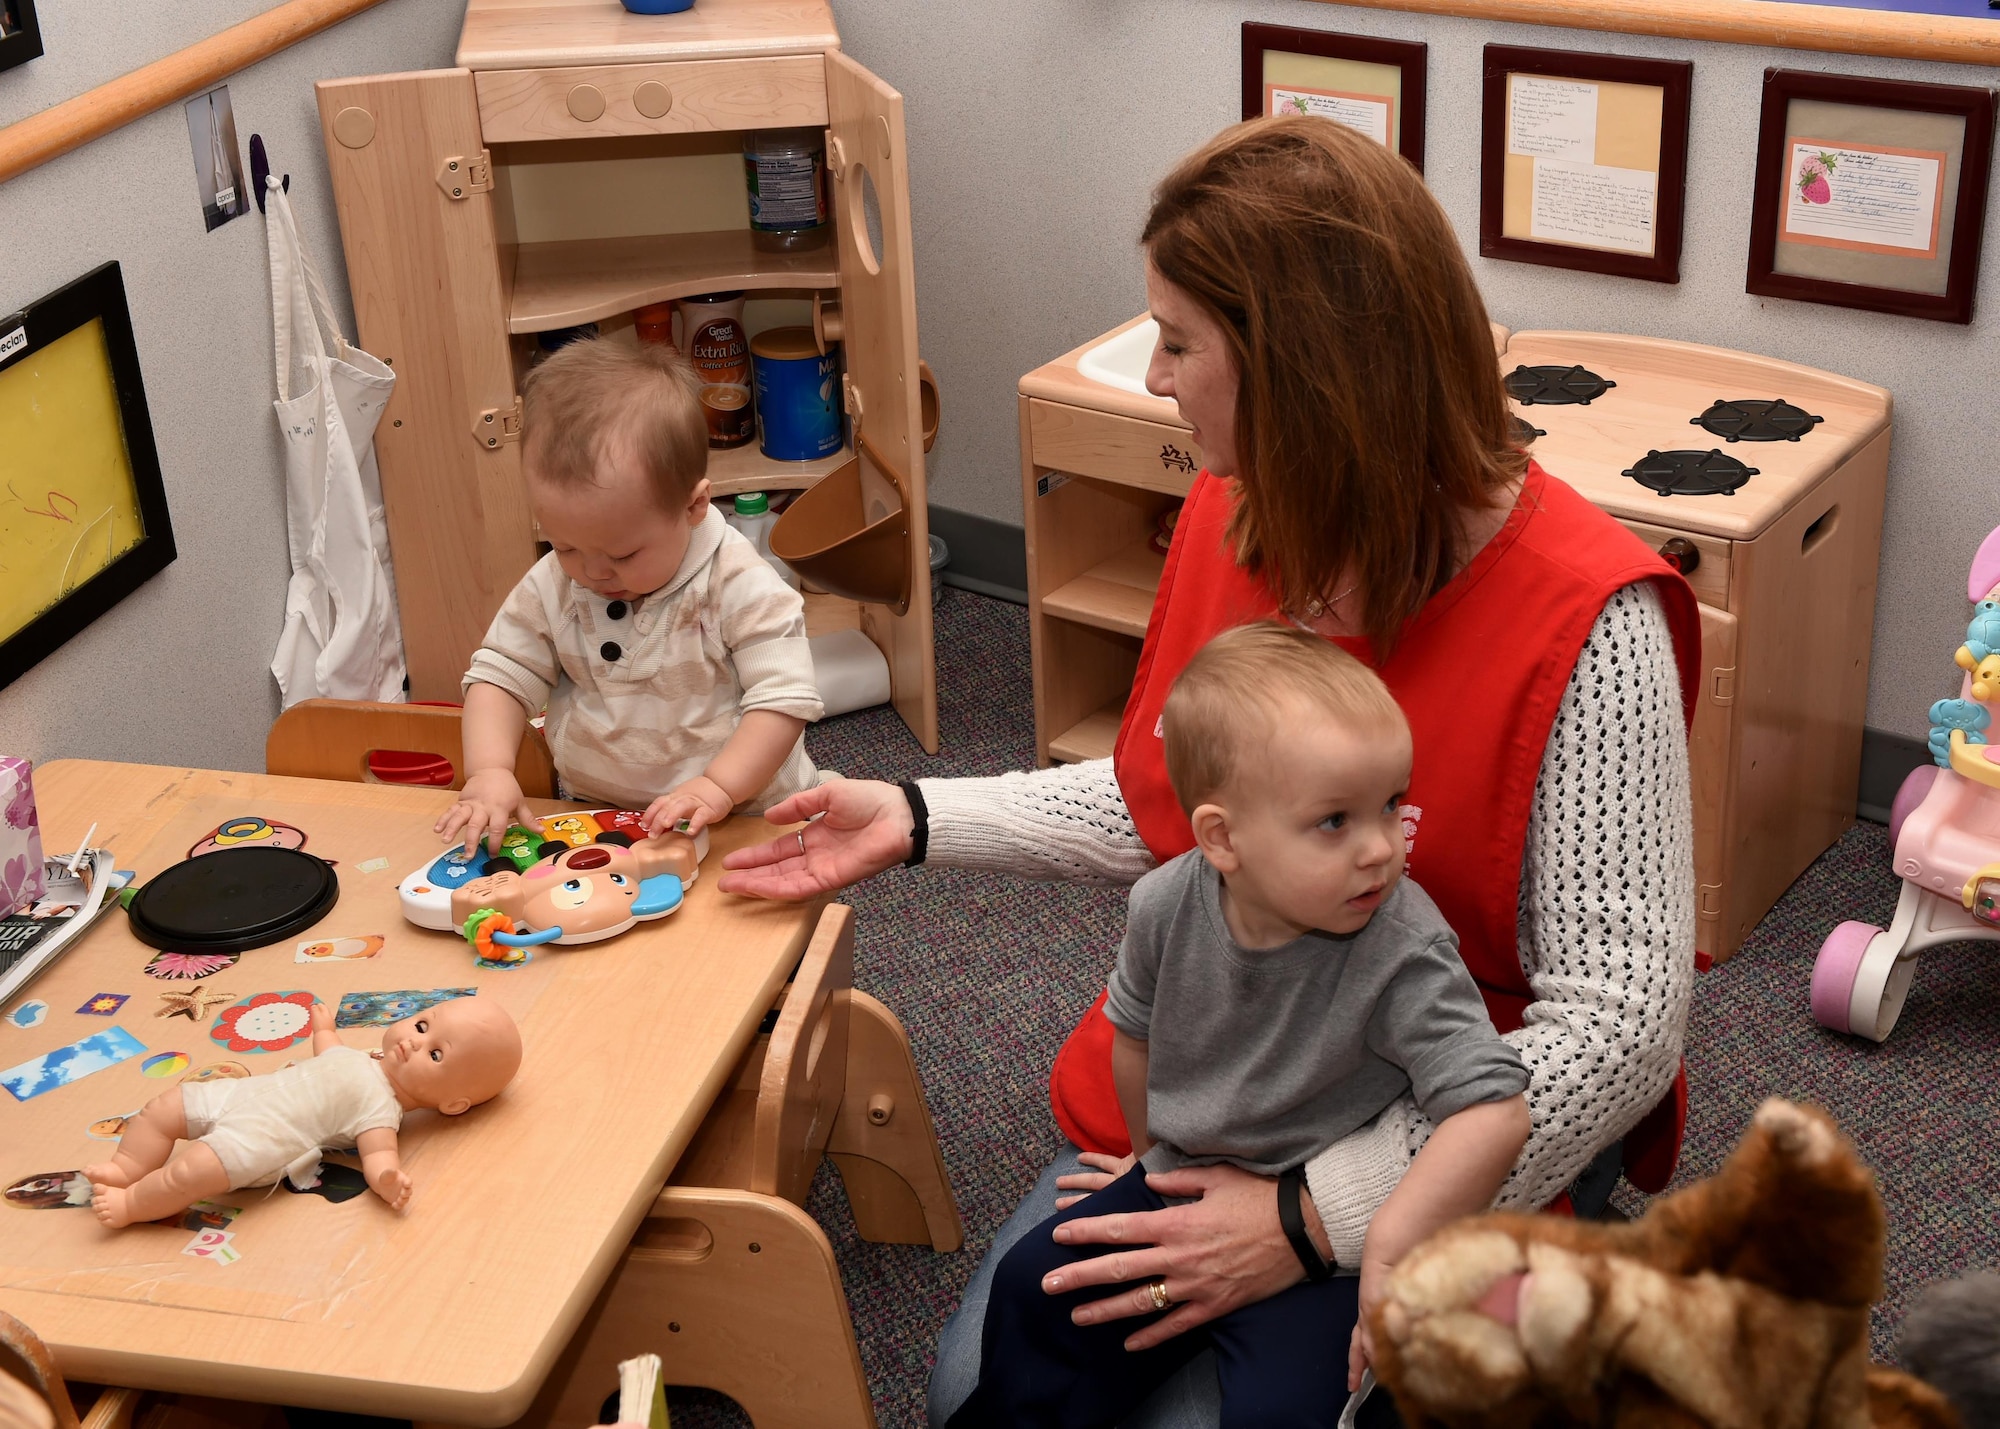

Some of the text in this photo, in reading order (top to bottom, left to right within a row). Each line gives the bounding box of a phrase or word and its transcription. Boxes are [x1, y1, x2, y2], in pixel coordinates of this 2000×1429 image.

[708, 324, 733, 336] Great
[0, 333, 25, 353] eclan
[715, 334, 734, 342] Value
[694, 344, 727, 359] Extra
[700, 361, 723, 369] Coffee
[186, 1232, 226, 1256] 2
